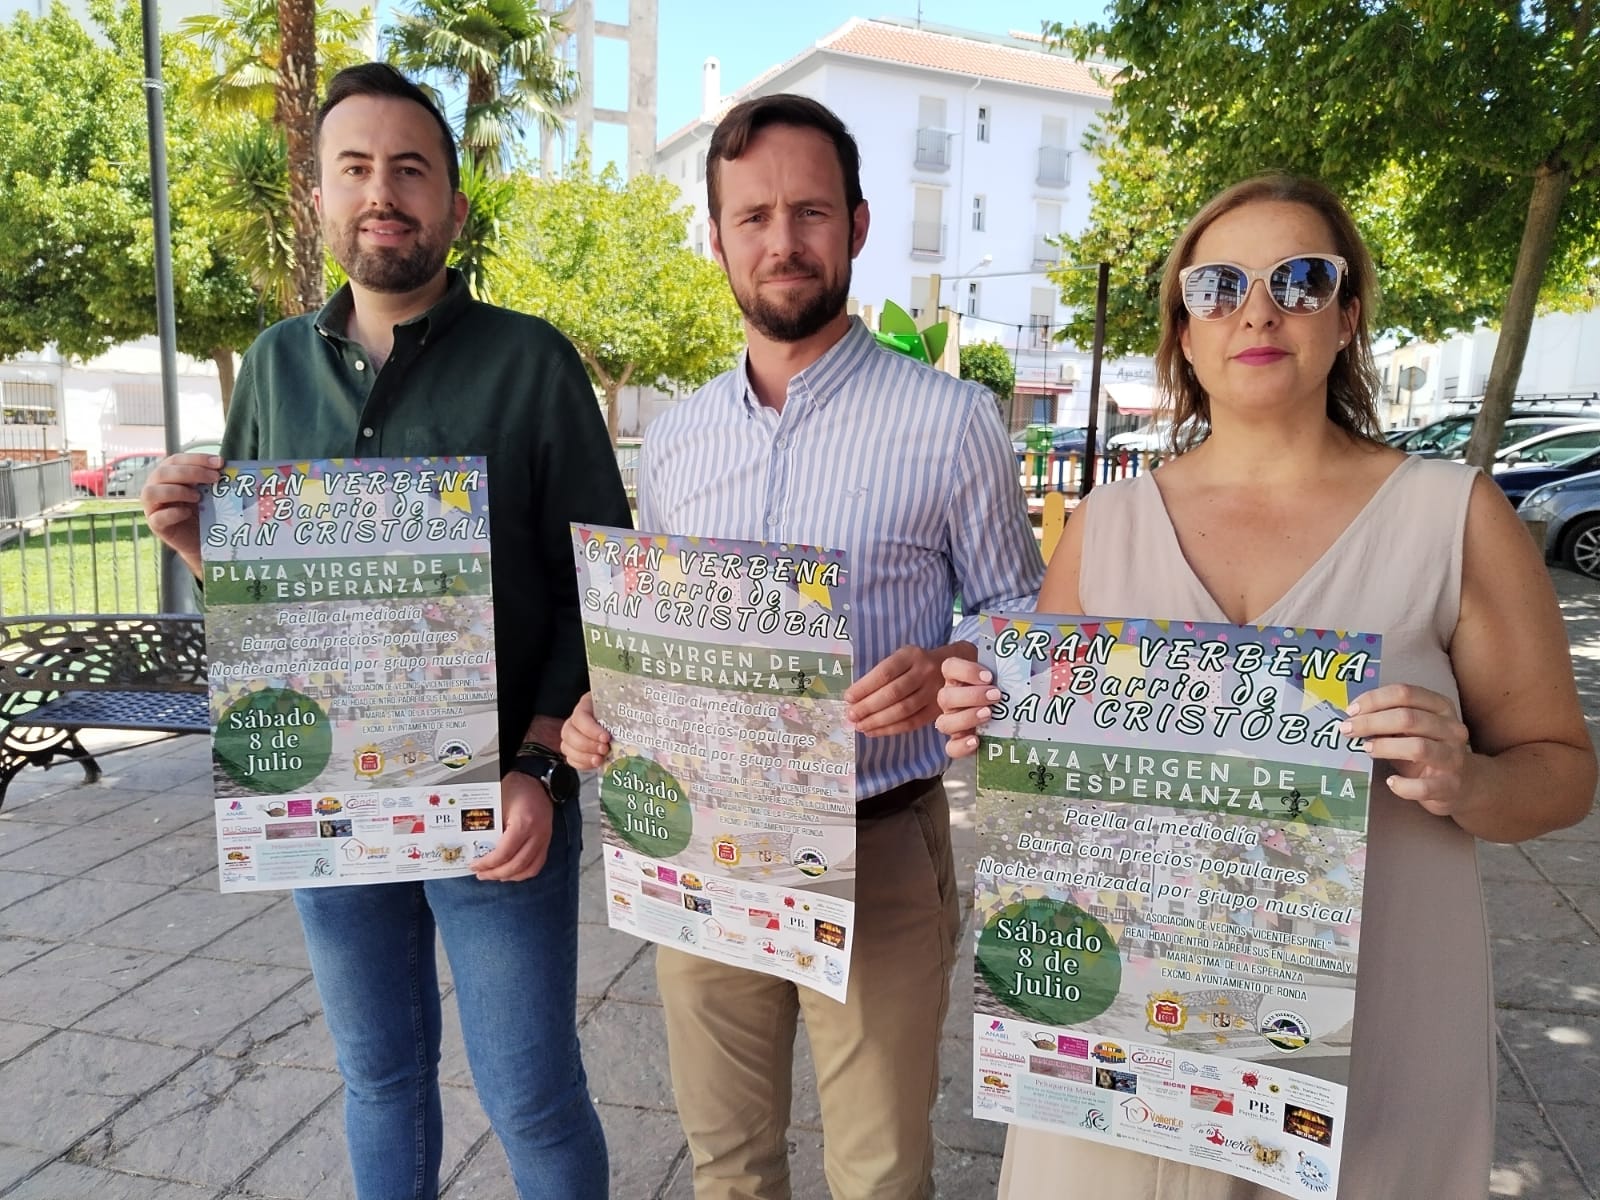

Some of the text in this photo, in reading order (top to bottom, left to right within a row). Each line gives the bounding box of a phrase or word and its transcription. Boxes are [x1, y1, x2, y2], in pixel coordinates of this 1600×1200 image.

[212, 470, 480, 497] GRAN VERBENA
[274, 495, 424, 521] Barrio de
[207, 516, 488, 547] SAN CRISTÓBAL
[212, 557, 483, 582] PLAZA VIRGEN DE LA
[584, 538, 841, 588] GRAN VERBENA
[277, 577, 424, 598] ESPERANZA
[636, 572, 782, 608] Barrio de
[278, 606, 422, 626] Paella al mediodía
[584, 587, 850, 640] SAN CRISTÓBAL
[242, 630, 458, 653] Barra con precios populares
[591, 630, 844, 677] PLAZA VIRGEN DE LA
[993, 628, 1371, 683] GRAN VERBENA
[211, 651, 490, 677] Noche amenizada por grupo musical
[642, 657, 780, 691] ESPERANZA
[385, 683, 393, 691] DE
[644, 687, 778, 718] Paella al mediodía
[1069, 665, 1278, 709] Barrio de
[230, 708, 316, 731] Sábado
[991, 692, 1076, 726] SAN
[250, 731, 299, 750] 8 de
[437, 722, 444, 730] DE
[618, 704, 817, 748] Barra con precios populares
[244, 753, 302, 776] Julio
[636, 733, 706, 758] amenizada
[711, 748, 735, 764] por
[738, 751, 782, 770] grupo
[788, 756, 849, 776] musical
[612, 769, 678, 803] Sábado
[988, 742, 1357, 799] PLAZA VIRGEN DE LA
[627, 794, 665, 819] 8 de
[1066, 772, 1265, 812] ESPERANZA
[623, 814, 669, 841] Julio
[1064, 808, 1258, 847] Paella al mediodía
[1018, 834, 1309, 886] Barra con precios populares
[979, 857, 1354, 925] Noche amenizada por grupo musical
[997, 918, 1102, 954] Sábado
[1125, 927, 1146, 938] REAL
[1149, 930, 1172, 942] HDAD
[1174, 934, 1184, 945] DE
[1213, 940, 1241, 953] PADRE
[1272, 949, 1283, 960] EN
[1285, 951, 1297, 963] LA
[1299, 954, 1342, 971] COLUMNA
[1344, 963, 1352, 972] Y
[1197, 920, 1208, 931] DE
[1210, 922, 1246, 937] VECINOS
[1249, 927, 1290, 943] "VICENTE
[1291, 935, 1332, 949] ESPINEL"
[1017, 945, 1080, 976] 8 de
[1224, 959, 1236, 970] DE
[1238, 961, 1249, 972] LA
[1252, 964, 1303, 982] ESPERANZA
[1010, 971, 1082, 1002] Julio
[1195, 973, 1261, 992] AYUNTAMIENTO
[1264, 984, 1274, 995] DE
[1276, 986, 1307, 1001] RONDA
